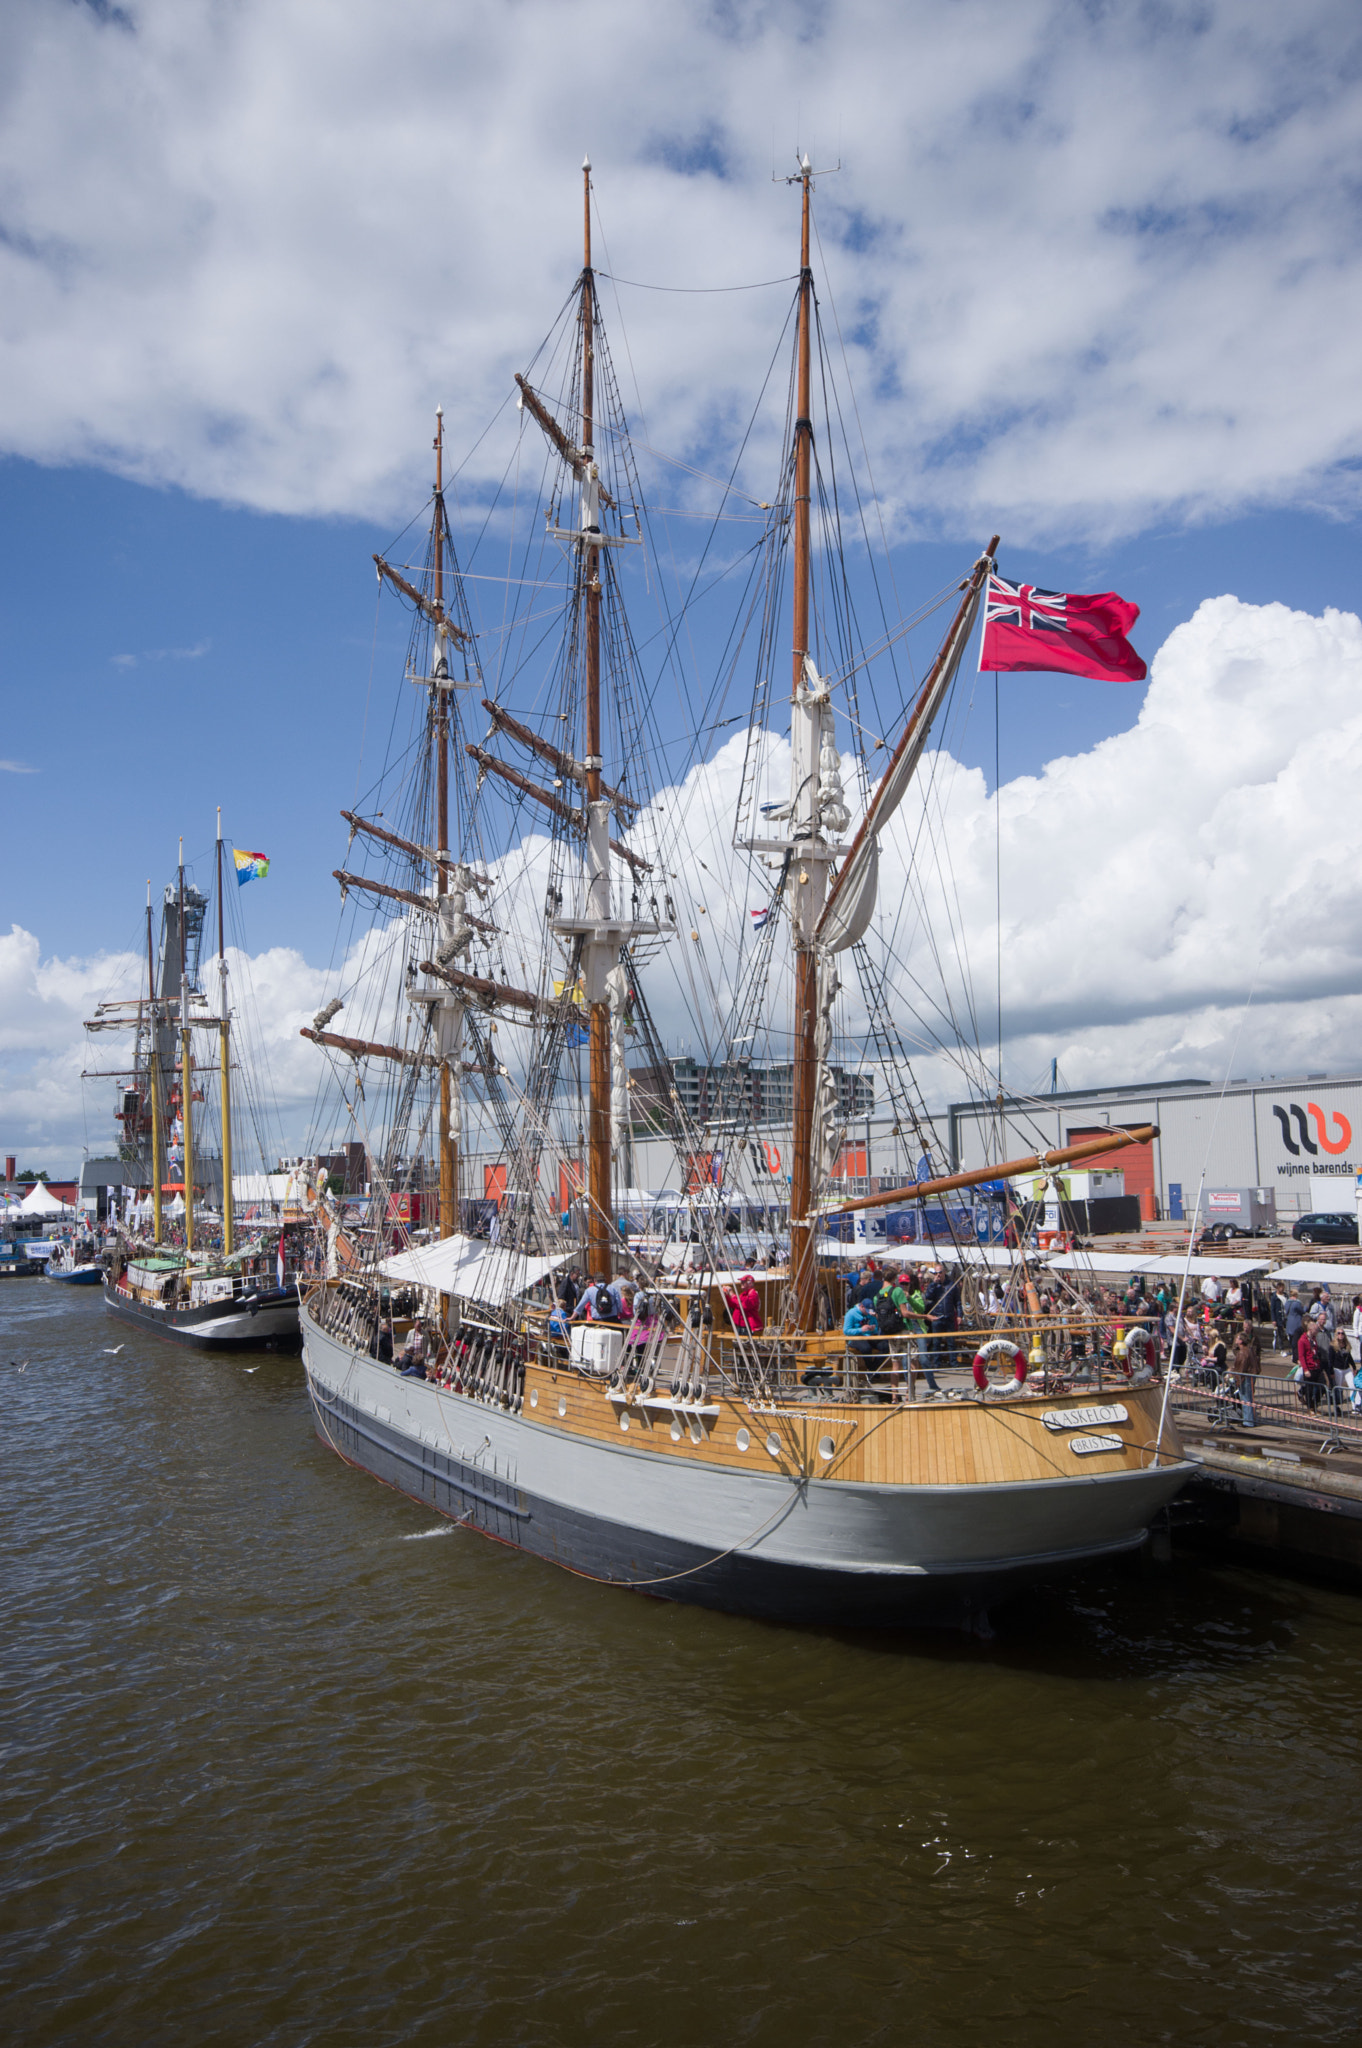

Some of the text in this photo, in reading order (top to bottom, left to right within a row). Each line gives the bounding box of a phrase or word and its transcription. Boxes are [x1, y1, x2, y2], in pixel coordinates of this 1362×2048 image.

[1277, 1161, 1353, 1177] wijnne barends
[1051, 1405, 1120, 1425] KASKELOT
